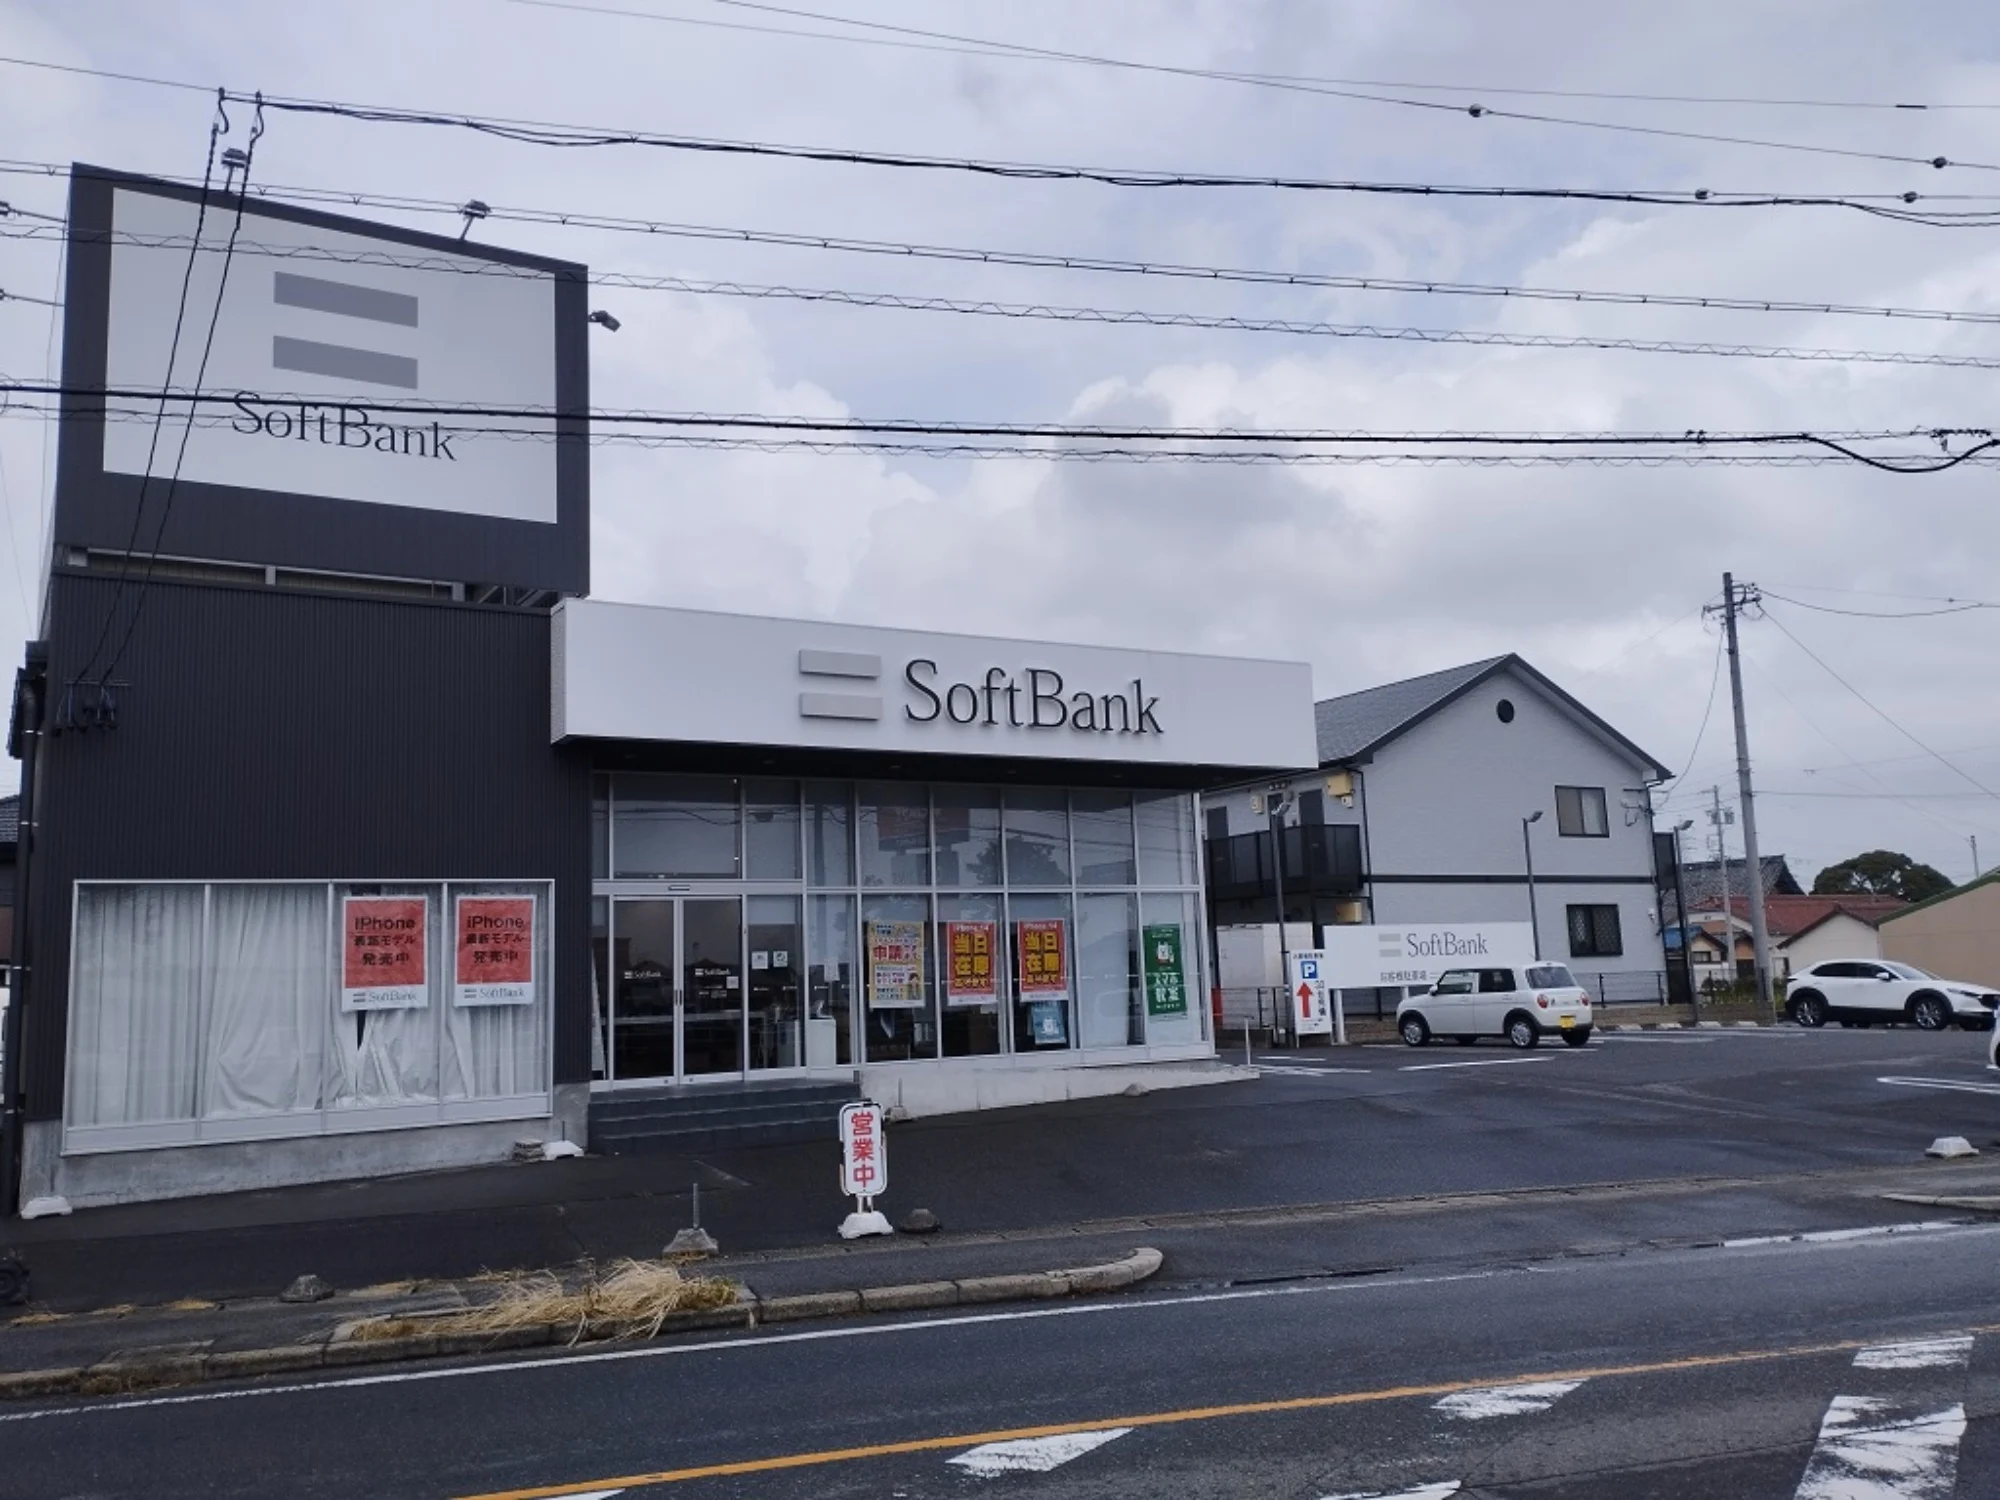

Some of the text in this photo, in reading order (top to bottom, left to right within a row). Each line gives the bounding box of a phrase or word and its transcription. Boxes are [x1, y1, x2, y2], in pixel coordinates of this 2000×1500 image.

[232, 391, 457, 461] SoftBank
[905, 659, 1164, 733] SoftBank
[355, 915, 416, 930] iPhone
[467, 915, 524, 929] iPhone
[954, 932, 988, 954] 当日
[1025, 931, 1058, 951] 当日
[1406, 931, 1489, 957] SoftBank
[362, 952, 410, 966] 発売中
[473, 950, 519, 964] 発売中
[1303, 963, 1316, 978] P
[851, 1111, 875, 1188] 営業中
